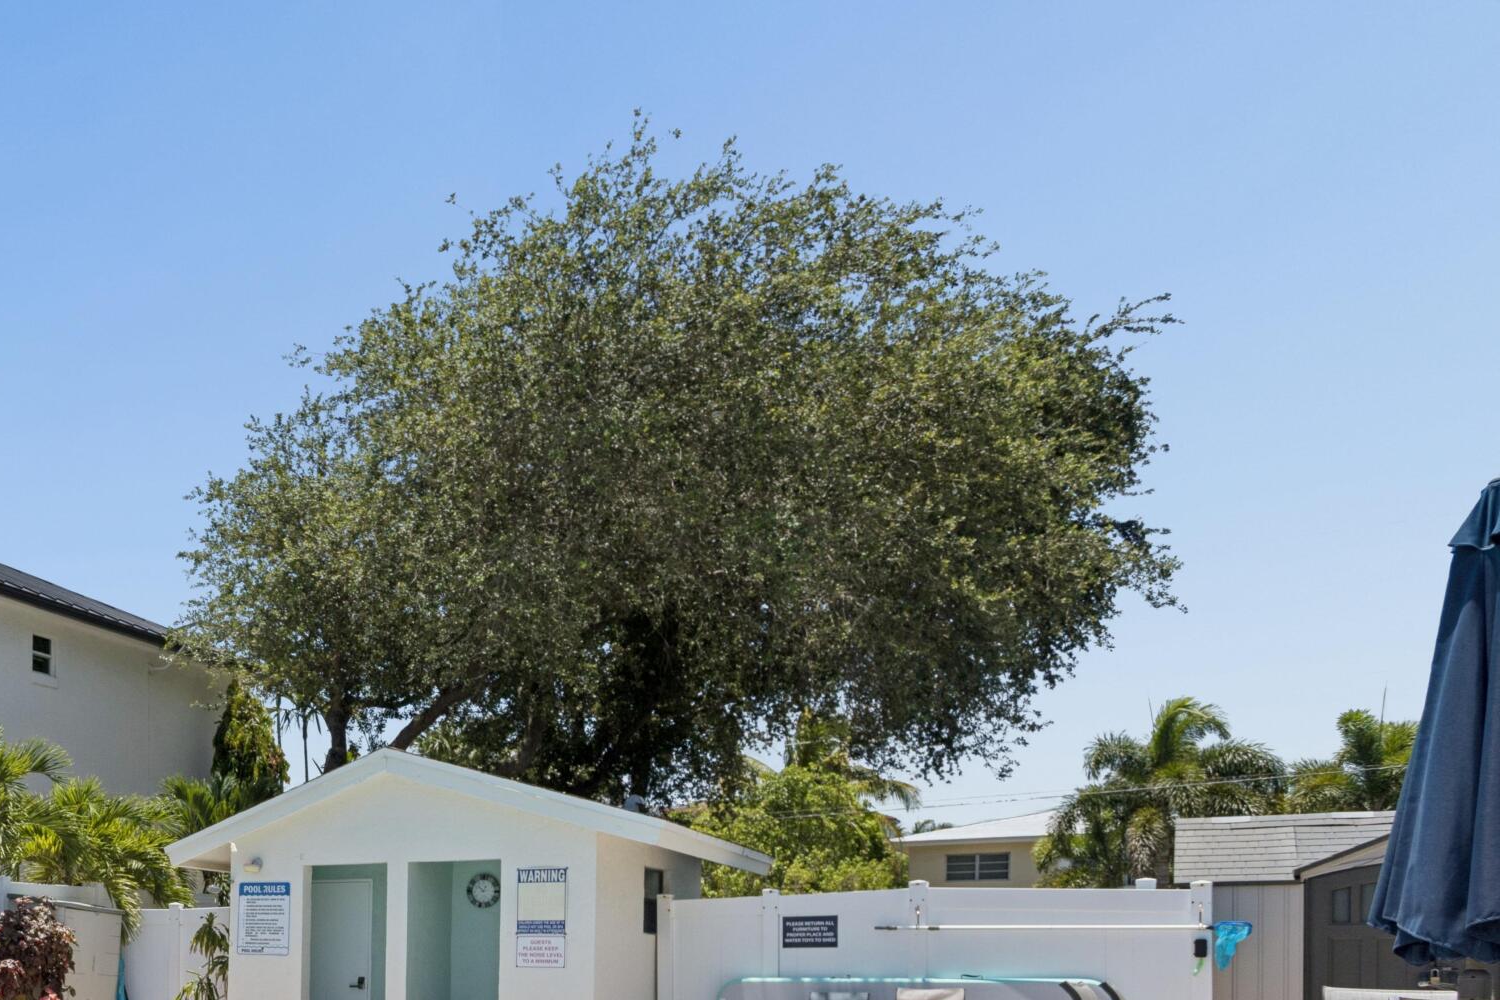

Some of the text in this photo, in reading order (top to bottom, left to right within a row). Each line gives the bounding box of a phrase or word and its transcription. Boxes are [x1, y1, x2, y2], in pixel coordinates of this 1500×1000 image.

[520, 870, 565, 882] WARNING
[244, 885, 286, 893] POOL RULES
